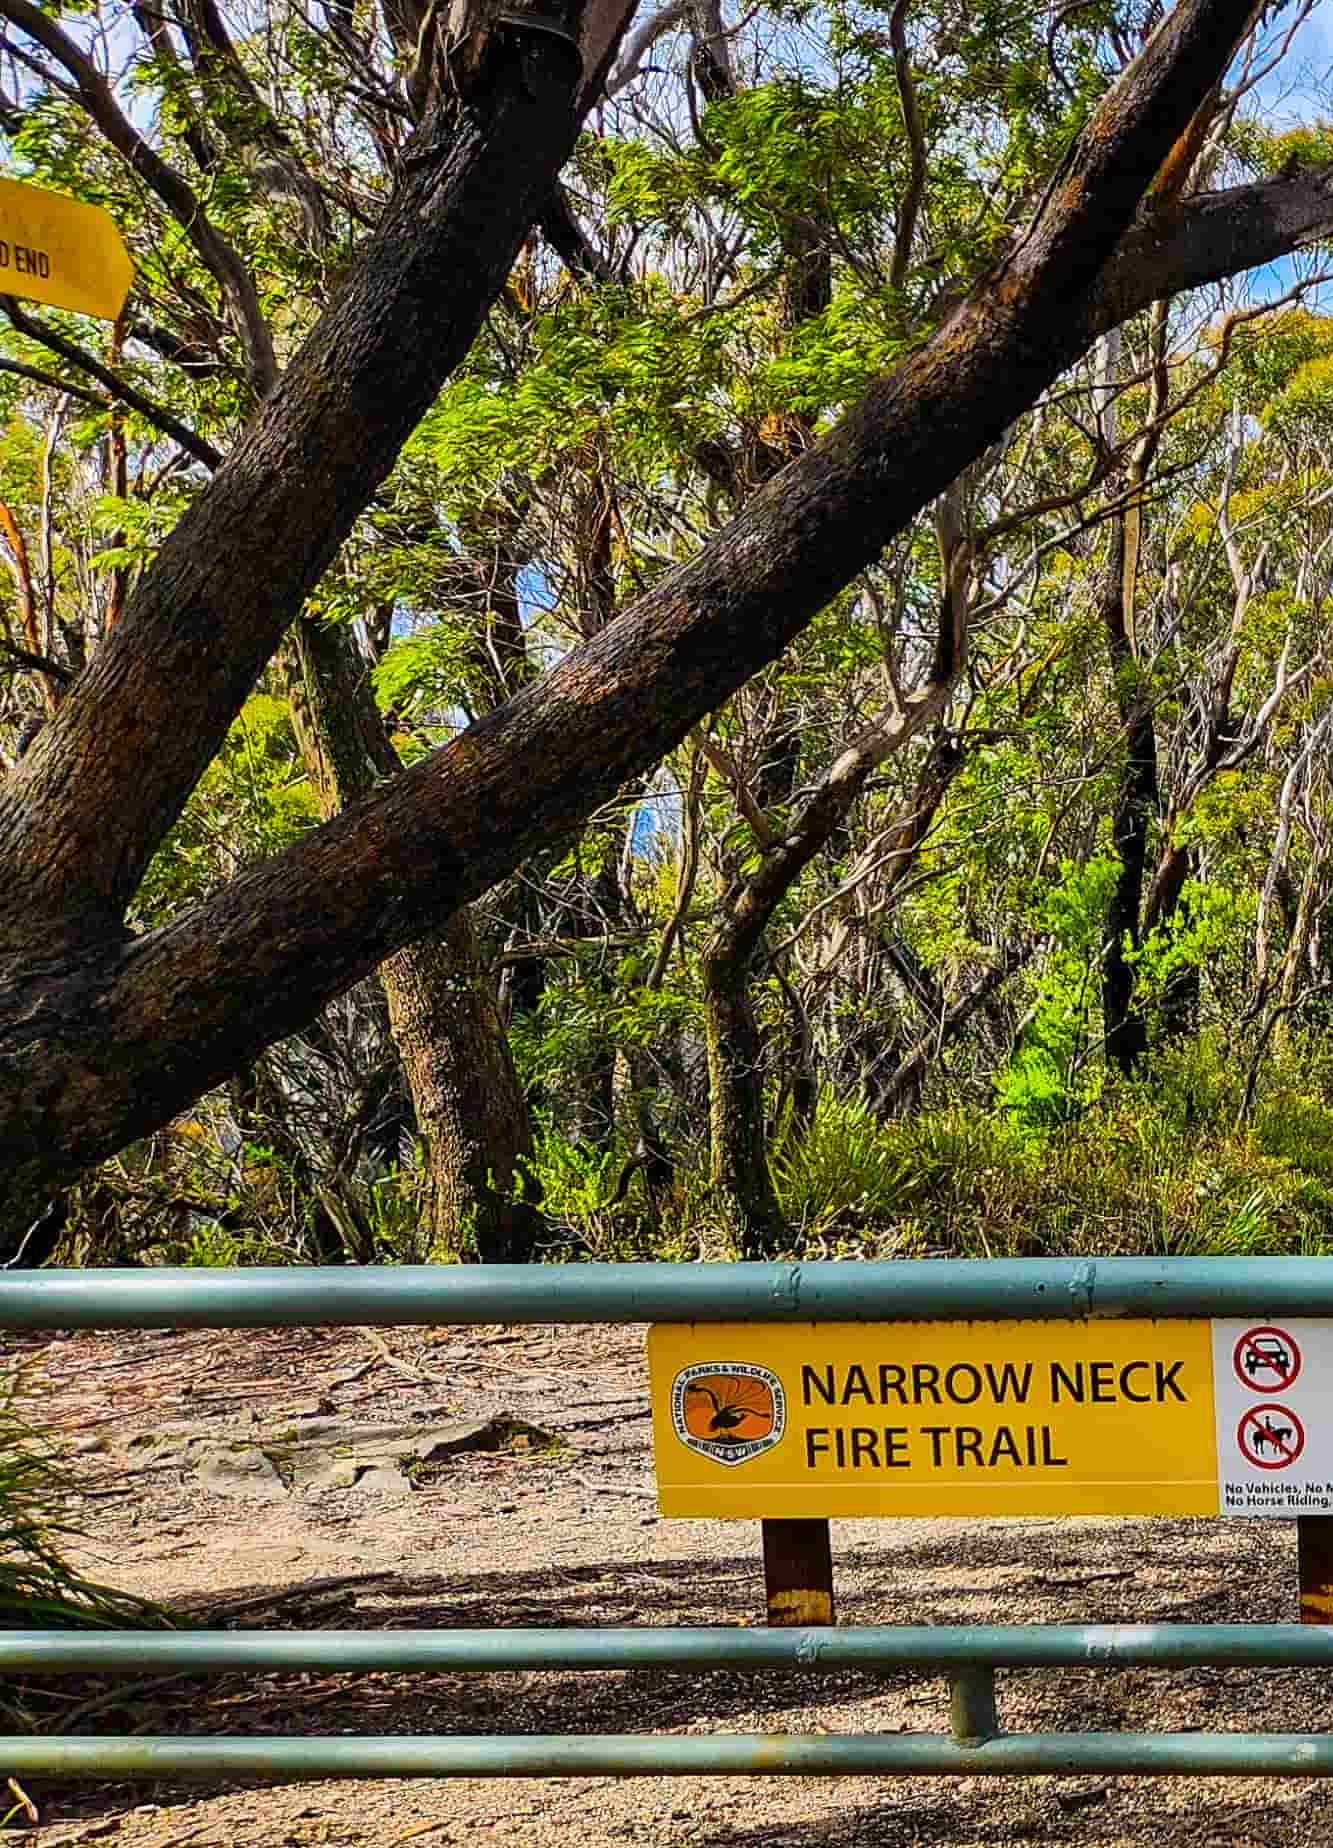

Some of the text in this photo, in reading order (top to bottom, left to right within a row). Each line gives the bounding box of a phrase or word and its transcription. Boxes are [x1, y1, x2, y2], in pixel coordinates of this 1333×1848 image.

[15, 245, 49, 279] END
[801, 1360, 1188, 1406] NARROW NECK
[805, 1425, 1068, 1468] FIRE TRAIL
[1225, 1484, 1242, 1494] No
[1245, 1483, 1301, 1496] Vehicles,
[1305, 1483, 1323, 1494] No
[1226, 1496, 1243, 1506] No
[1247, 1496, 1283, 1506] Horse
[1287, 1495, 1332, 1508] Riding,
